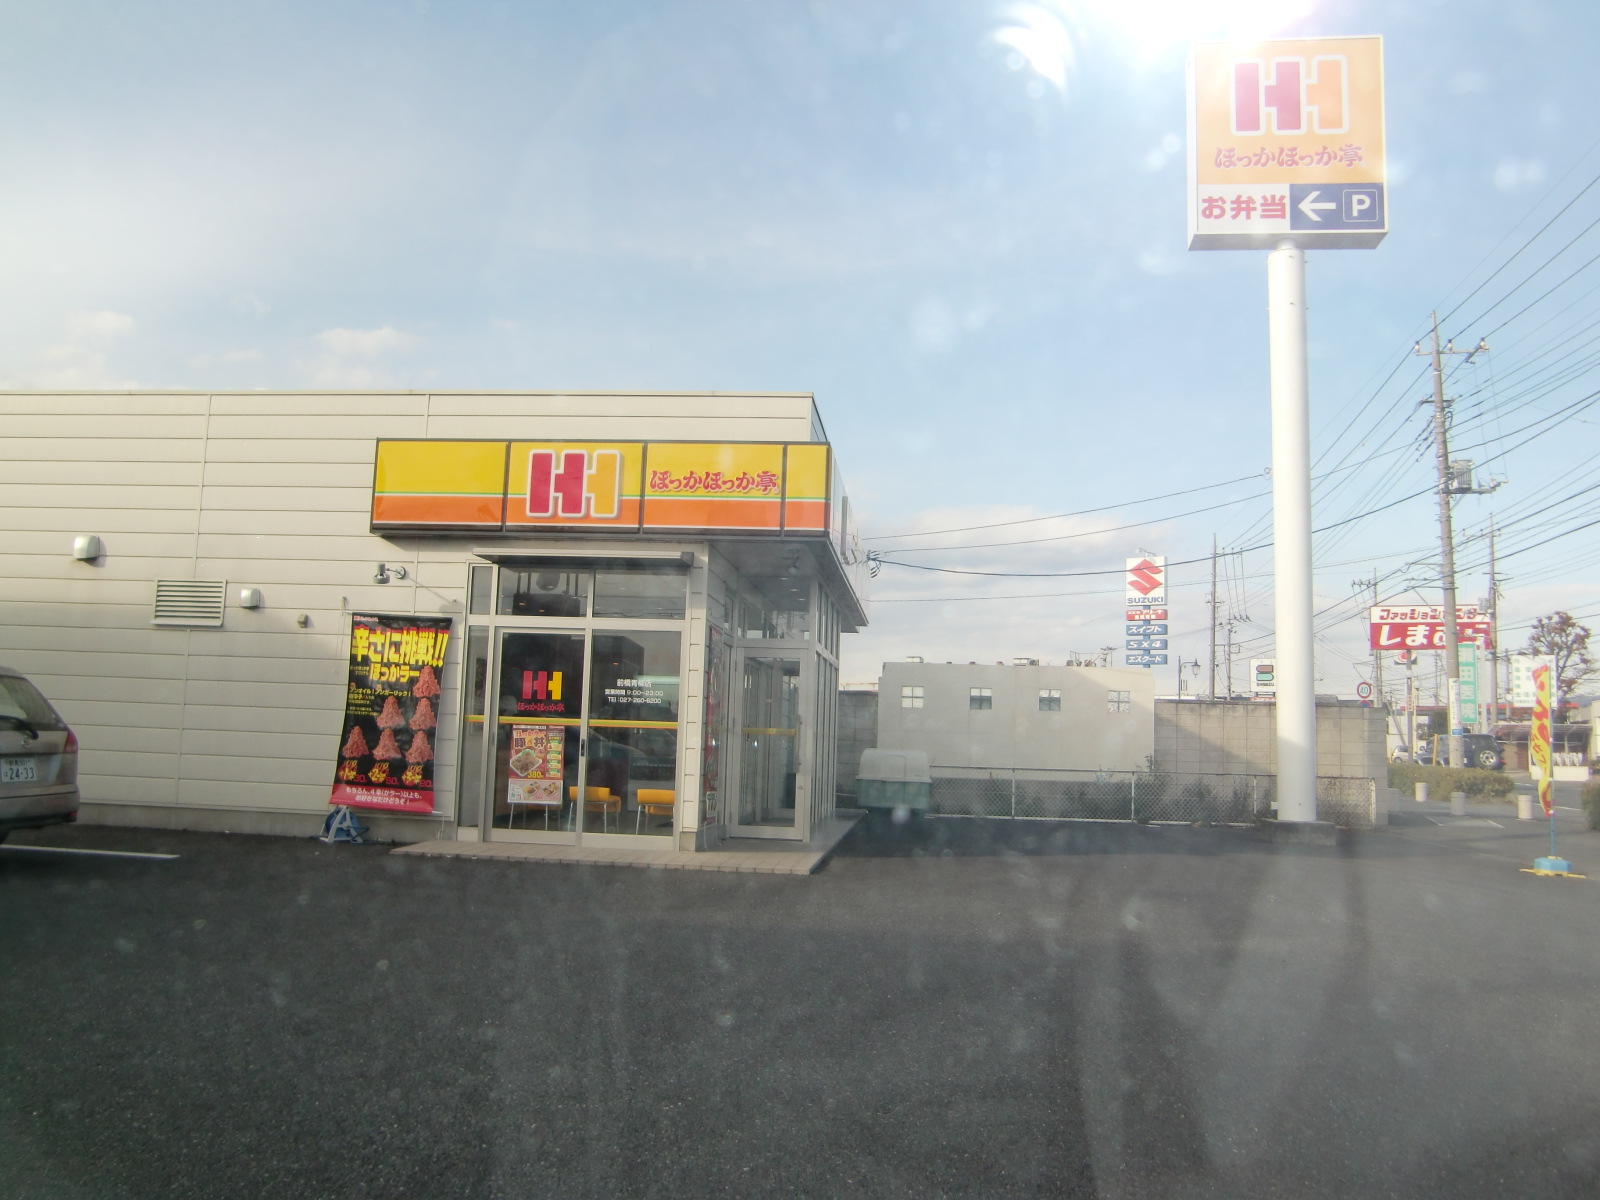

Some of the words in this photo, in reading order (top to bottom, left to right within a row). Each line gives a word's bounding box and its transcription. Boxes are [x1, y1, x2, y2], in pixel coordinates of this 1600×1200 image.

[1214, 144, 1364, 169] ほっかほっか亭
[1201, 194, 1287, 220] お弁当
[650, 470, 780, 495] ほっかほっか亭
[1127, 596, 1164, 604] SUZUKI
[1128, 625, 1162, 634] スイフト
[351, 624, 449, 668] 辛さに挑戦!!
[1128, 655, 1162, 663] エスクード
[1360, 686, 1369, 694] 40
